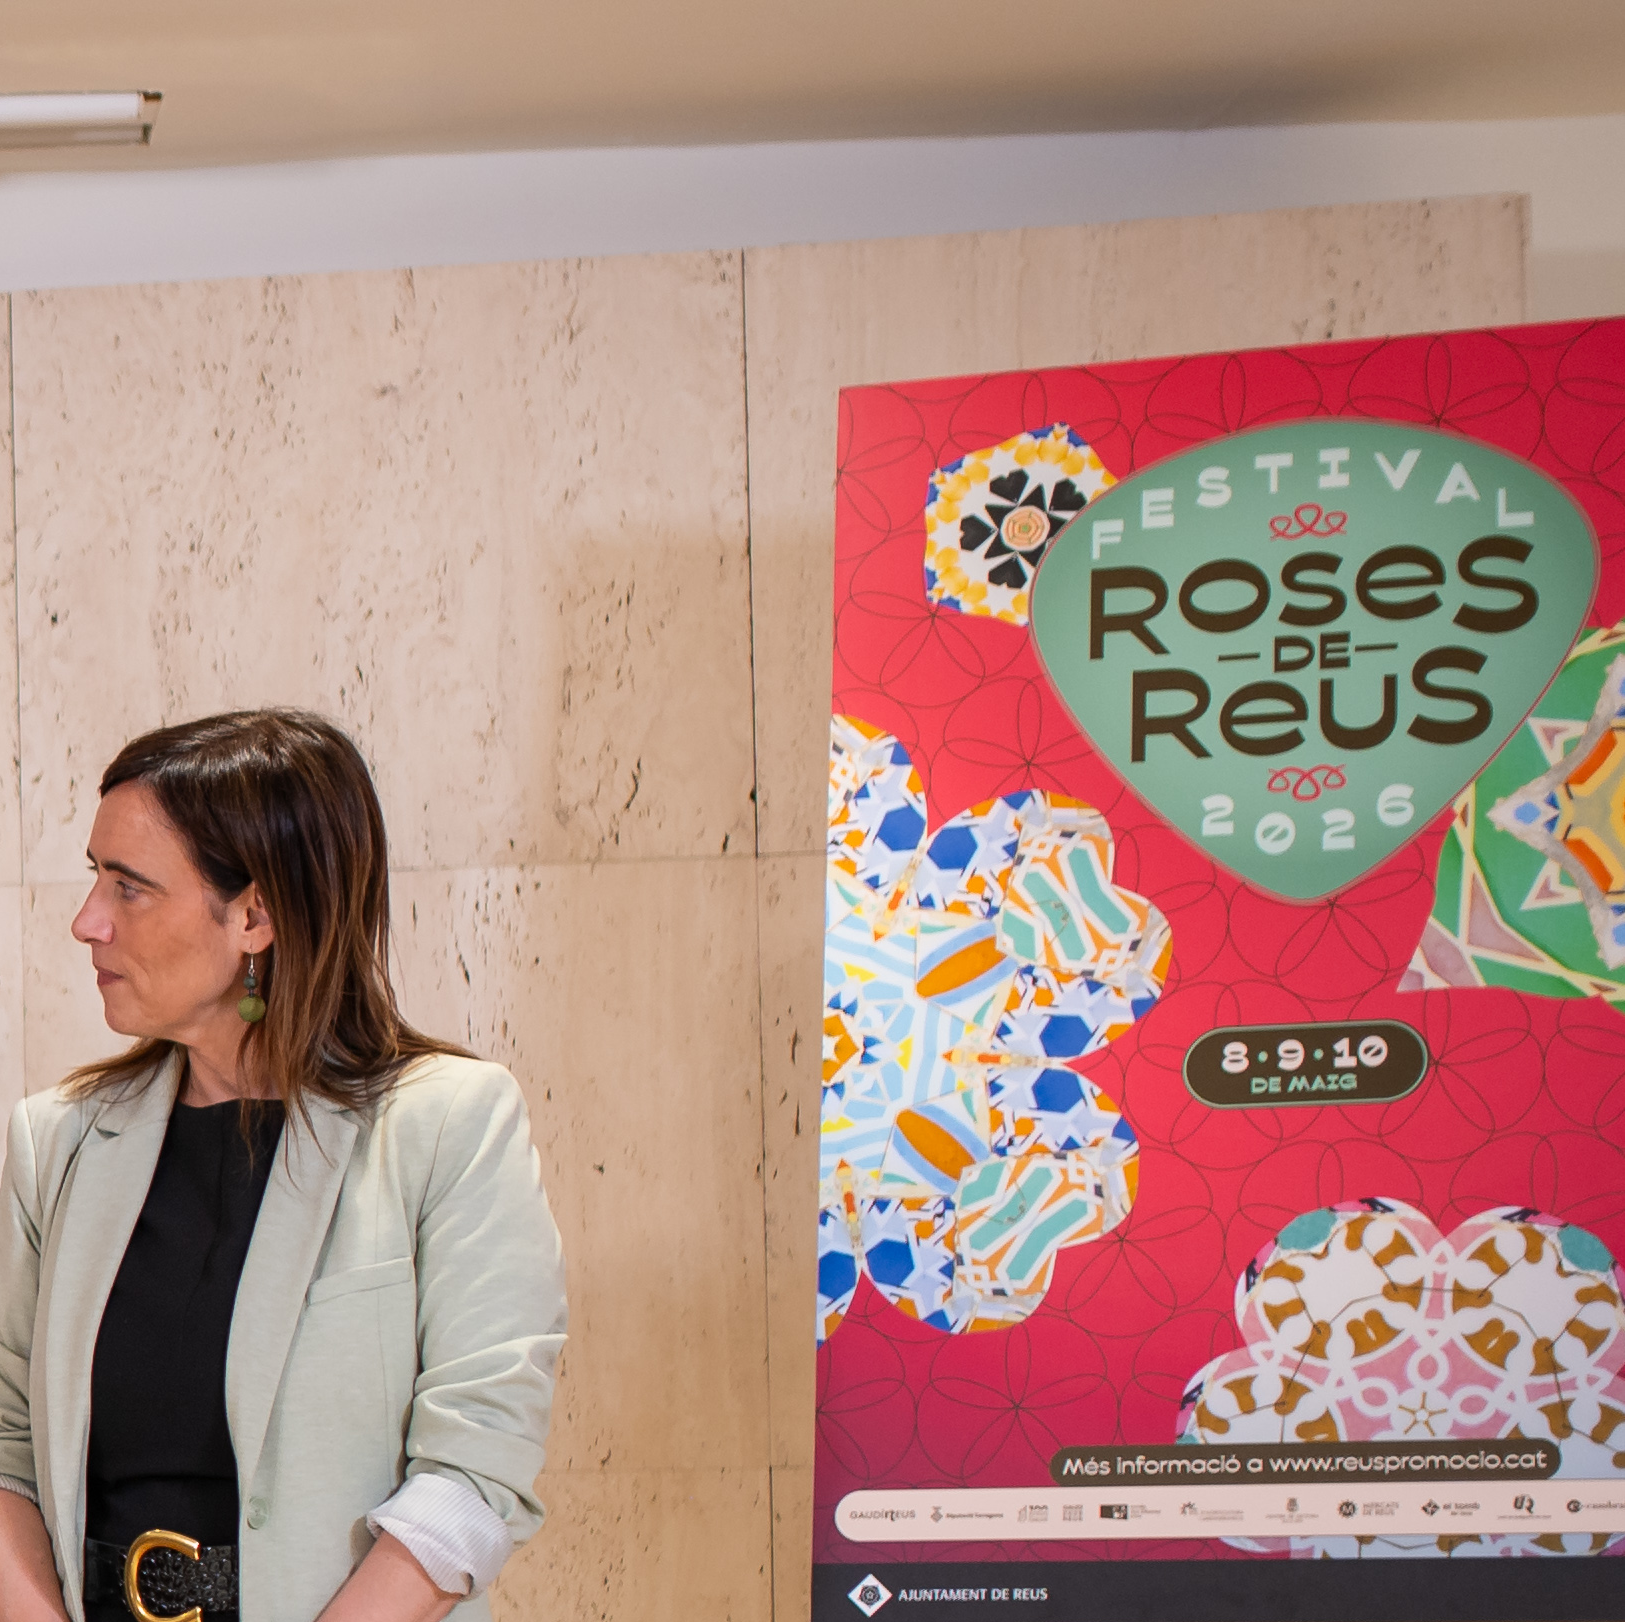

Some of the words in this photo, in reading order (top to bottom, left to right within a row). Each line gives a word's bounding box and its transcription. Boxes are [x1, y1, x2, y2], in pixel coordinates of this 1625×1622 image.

[1091, 448, 1535, 560] FESTIVAL
[1272, 631, 1351, 674] DE
[1200, 783, 1416, 855] 2026
[1250, 1076, 1282, 1094] DE
[1286, 1073, 1358, 1093] MAIG
[1062, 1456, 1111, 1476] Més
[1116, 1453, 1241, 1475] informació
[1246, 1457, 1264, 1474] a
[1269, 1450, 1548, 1475] www.reuspromocio.cat
[899, 1588, 987, 1602] AJUNTAMENT
[990, 1588, 1010, 1601] DE
[1012, 1587, 1048, 1601] REUS
